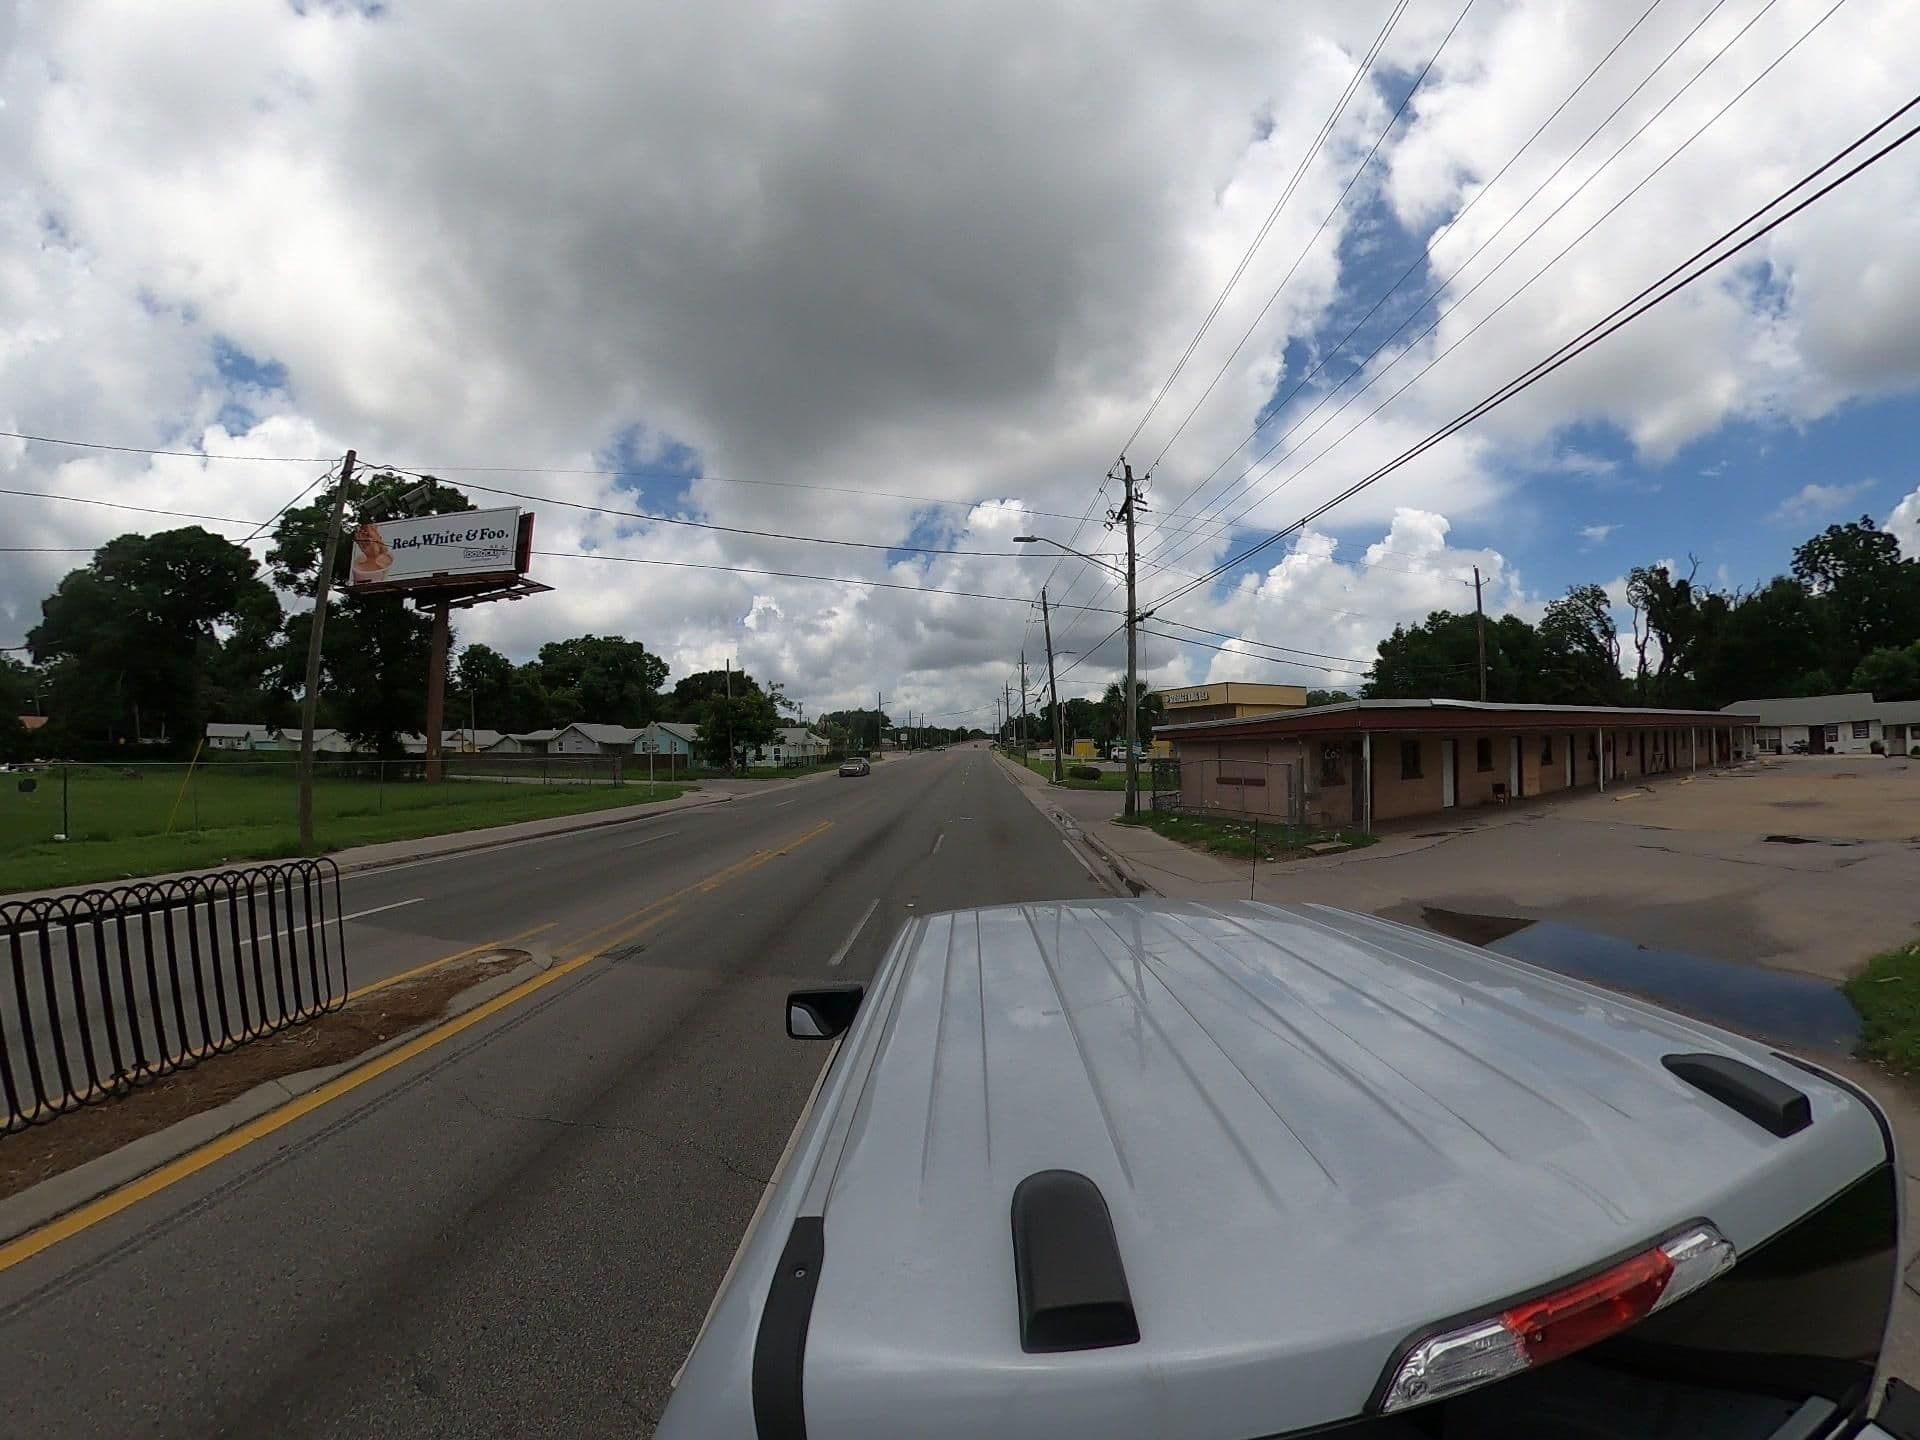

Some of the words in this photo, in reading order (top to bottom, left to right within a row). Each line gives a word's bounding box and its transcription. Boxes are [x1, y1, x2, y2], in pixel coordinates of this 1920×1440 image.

[392, 535, 420, 550] Red,
[422, 529, 463, 545] White
[465, 529, 479, 541] &
[479, 528, 509, 540] Foo.
